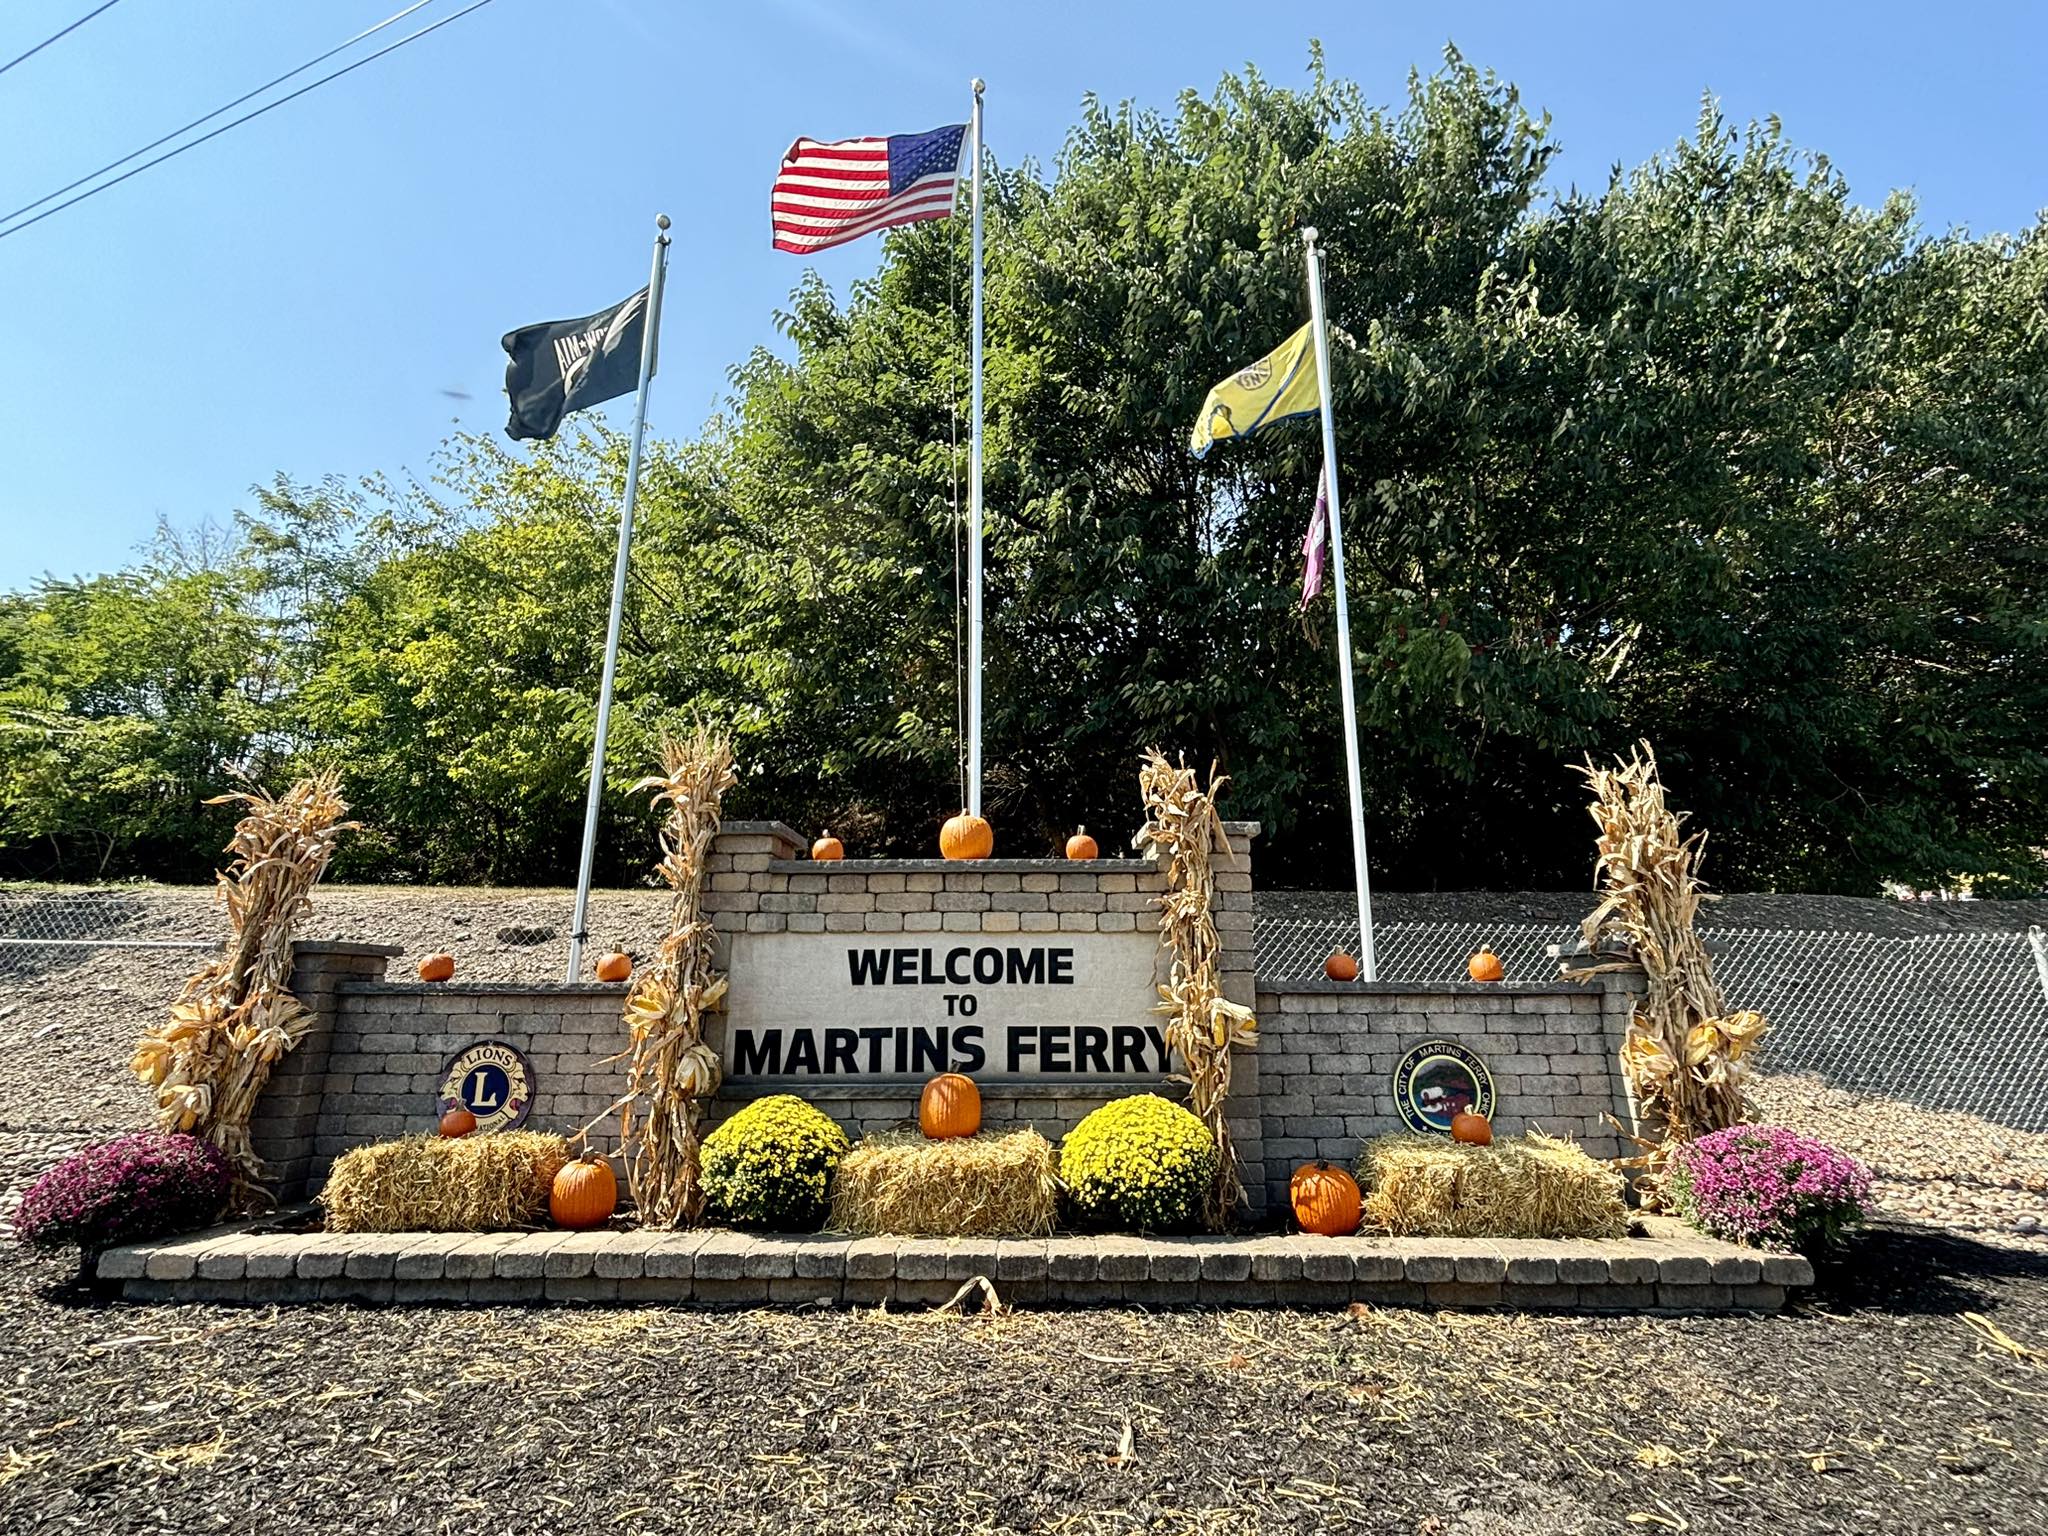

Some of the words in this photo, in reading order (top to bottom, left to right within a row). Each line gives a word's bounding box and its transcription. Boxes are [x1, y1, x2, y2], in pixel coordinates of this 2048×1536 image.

[847, 947, 1075, 986] WELCOME
[943, 994, 978, 1017] TO
[466, 1048, 512, 1066] LIONS
[733, 1025, 985, 1076] MARTINS
[1007, 1025, 1176, 1074] FERRY
[1418, 1044, 1462, 1058] MARTINS
[1404, 1056, 1416, 1071] OF
[470, 1072, 497, 1107] L
[1398, 1072, 1409, 1095] CITY
[1400, 1098, 1415, 1120] THE
